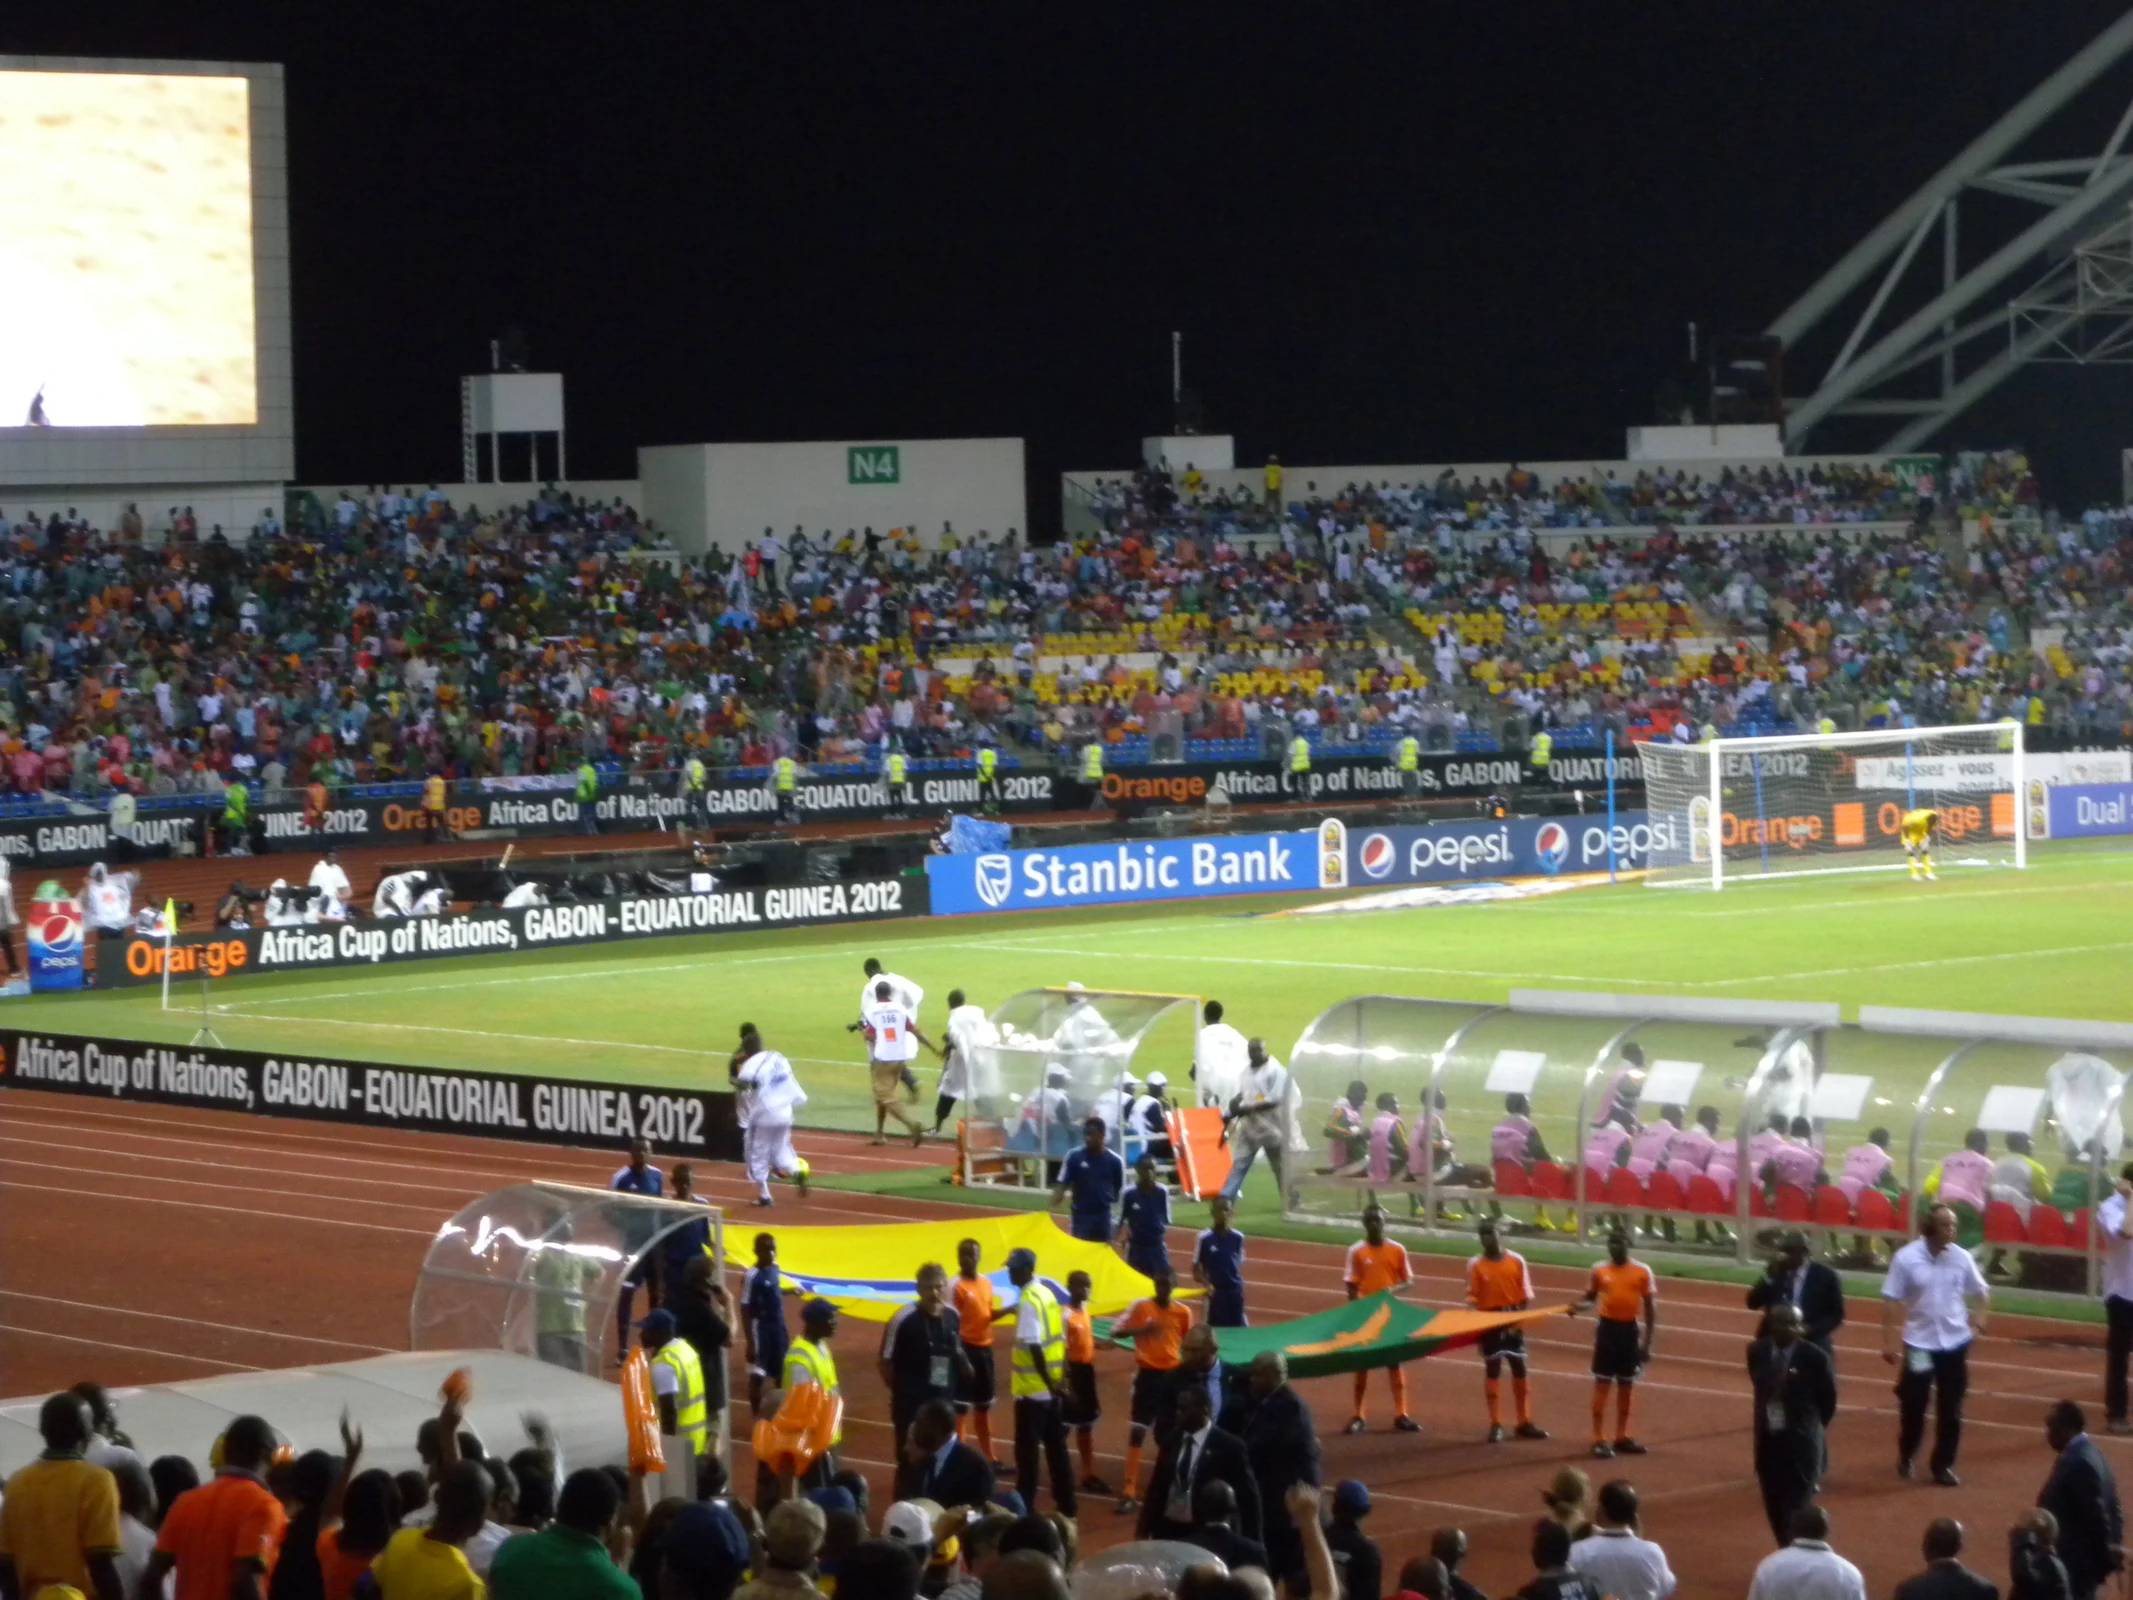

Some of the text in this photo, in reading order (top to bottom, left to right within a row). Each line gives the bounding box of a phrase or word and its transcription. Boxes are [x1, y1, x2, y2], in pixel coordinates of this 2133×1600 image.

[854, 452, 894, 478] N4
[1102, 773, 1205, 802] Orange
[1213, 770, 1277, 795] Africa
[1281, 769, 1324, 797] Cp
[1327, 767, 1349, 791] of
[1759, 753, 1809, 776] 2012
[382, 803, 481, 833] Orage
[488, 799, 549, 825] Africa
[551, 797, 580, 822] Cu
[596, 796, 617, 819] of
[619, 792, 688, 818] Nation
[923, 777, 1001, 804] GUIN
[1003, 776, 1053, 800] 2012
[1878, 802, 1982, 838] Onge
[2077, 791, 2126, 826] Dual
[37, 824, 106, 852] GABON
[323, 808, 369, 834] 2012
[1409, 826, 1511, 876] pepsi
[1582, 815, 1676, 865] pepsi
[1720, 812, 1823, 849] Orange
[1022, 837, 1293, 898] Stanbic Bank
[258, 929, 335, 963] Africa
[338, 925, 387, 962] Cup
[391, 920, 417, 954] of
[421, 916, 518, 950] Nations,
[765, 885, 849, 920] GUINEA
[850, 880, 902, 913] 2012
[15, 1036, 80, 1083] Africa
[83, 1042, 128, 1096] Cup
[131, 1048, 156, 1090] of
[158, 1050, 255, 1108] Nations,
[532, 1083, 637, 1138] GUINEA
[639, 1093, 706, 1145] 2012
